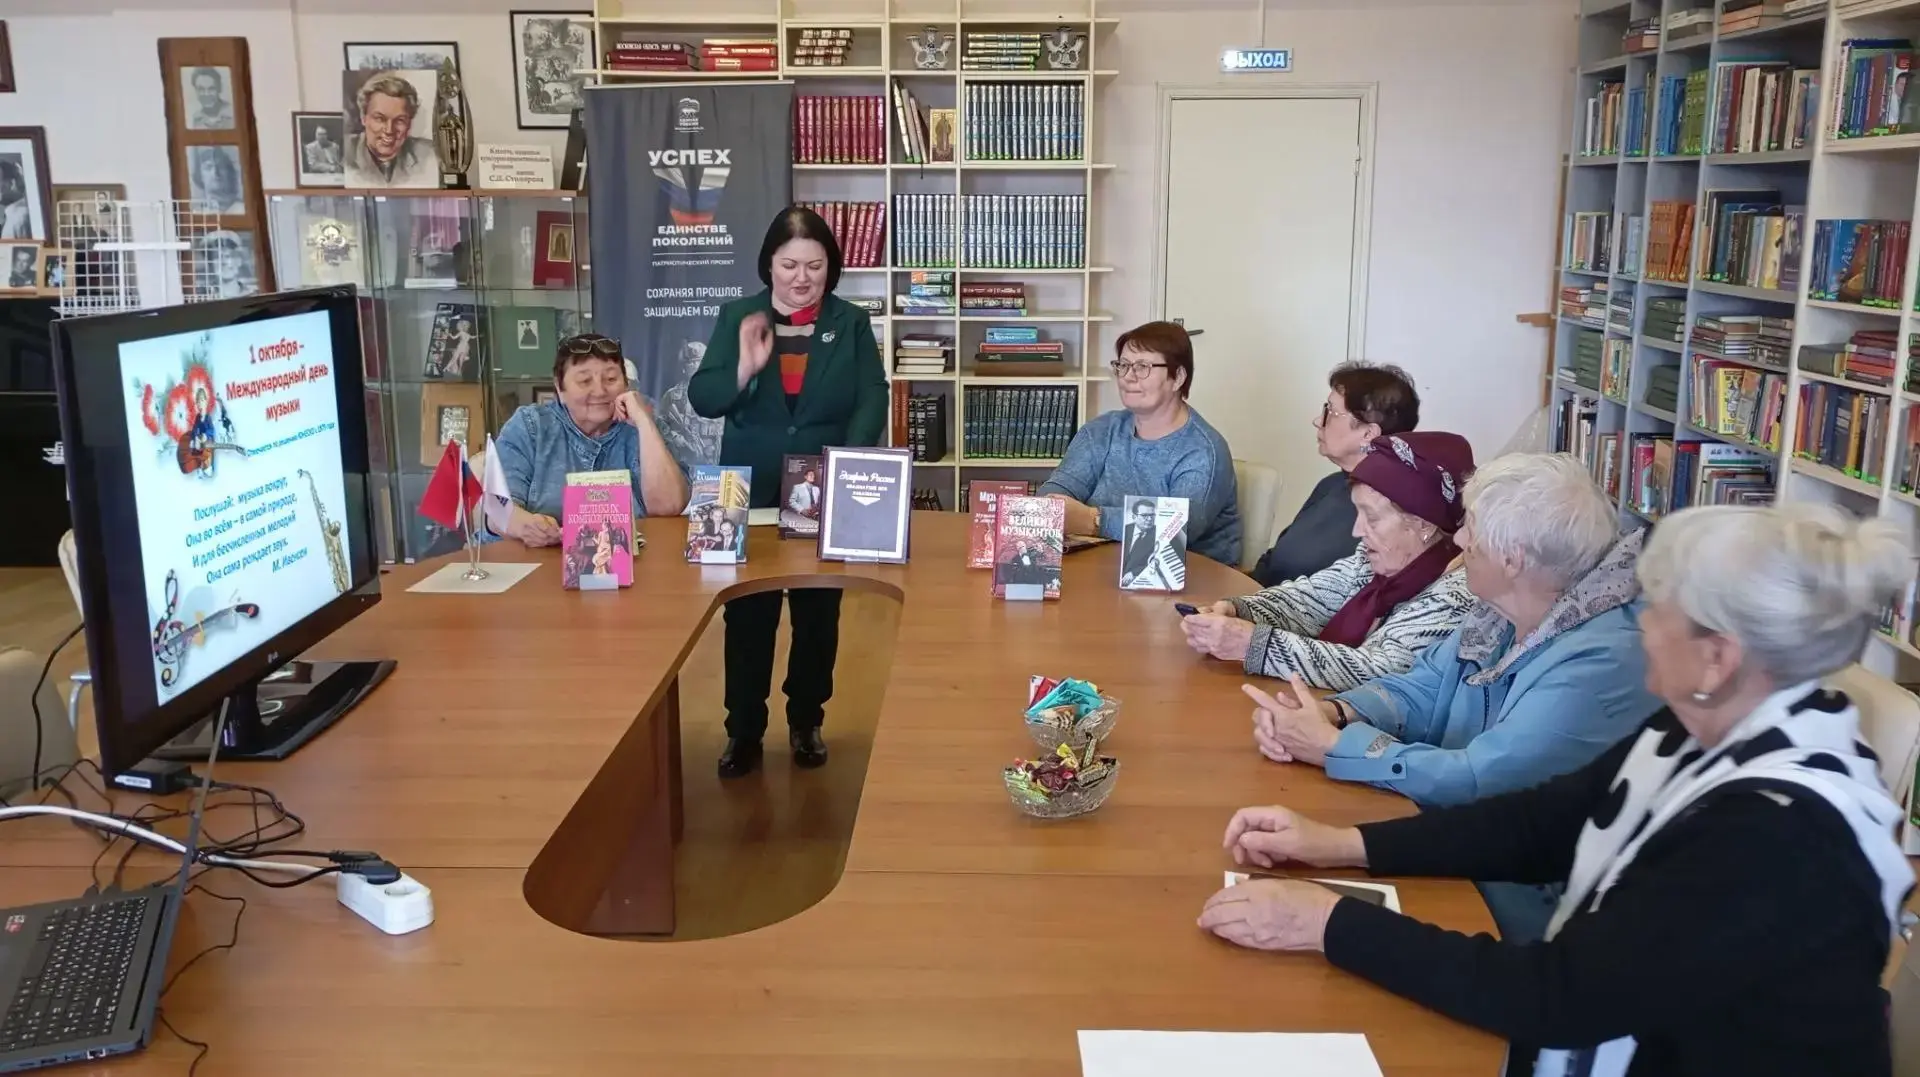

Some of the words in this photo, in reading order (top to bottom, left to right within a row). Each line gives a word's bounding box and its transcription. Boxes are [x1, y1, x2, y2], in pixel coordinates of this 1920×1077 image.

[1226, 52, 1285, 68] ЫХОД
[648, 149, 732, 167] УСПЕХ
[657, 224, 728, 235] ЕДИНСТВЕ
[652, 235, 734, 247] ПОКОЛЕНИЙ
[646, 287, 694, 299] СОХРАНЯЯ
[696, 286, 743, 298] ПРОШЛОЕ
[643, 305, 701, 318] ЗАЩИЩАЕМ
[249, 344, 256, 364] 1
[258, 336, 298, 363] октября
[226, 364, 307, 401] Международный
[308, 363, 329, 383] день
[265, 398, 301, 422] музыки
[1008, 515, 1054, 528] ВЕЛИКИХ
[186, 532, 202, 548] Она
[1000, 526, 1062, 538] МУЗЫКАНТОВ
[206, 567, 222, 584] Она
